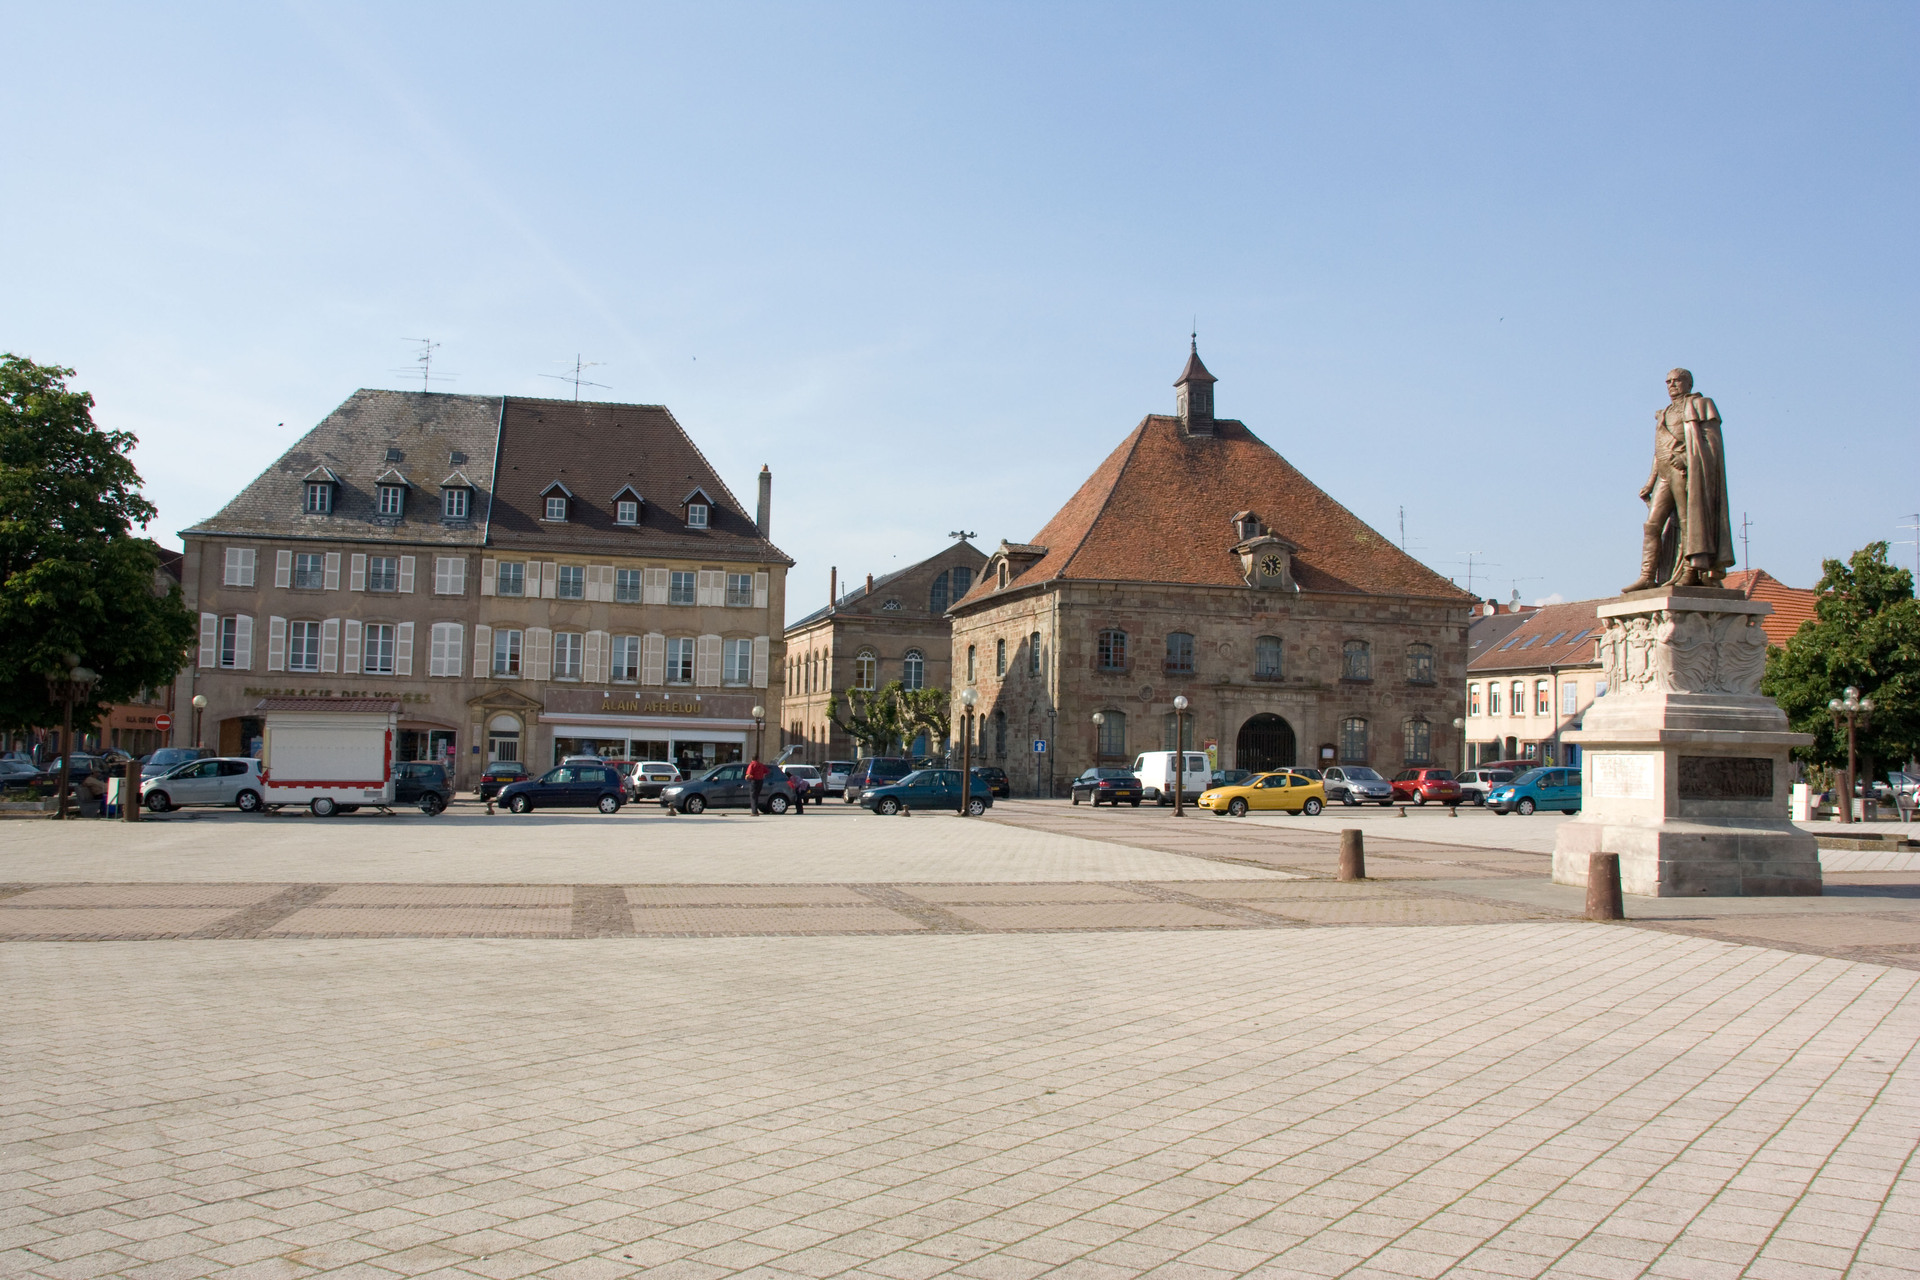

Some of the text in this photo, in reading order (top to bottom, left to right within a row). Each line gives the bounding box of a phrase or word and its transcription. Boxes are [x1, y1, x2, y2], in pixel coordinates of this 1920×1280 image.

[341, 690, 368, 698] DES
[601, 700, 701, 713] ALAIN AFFLELOU
